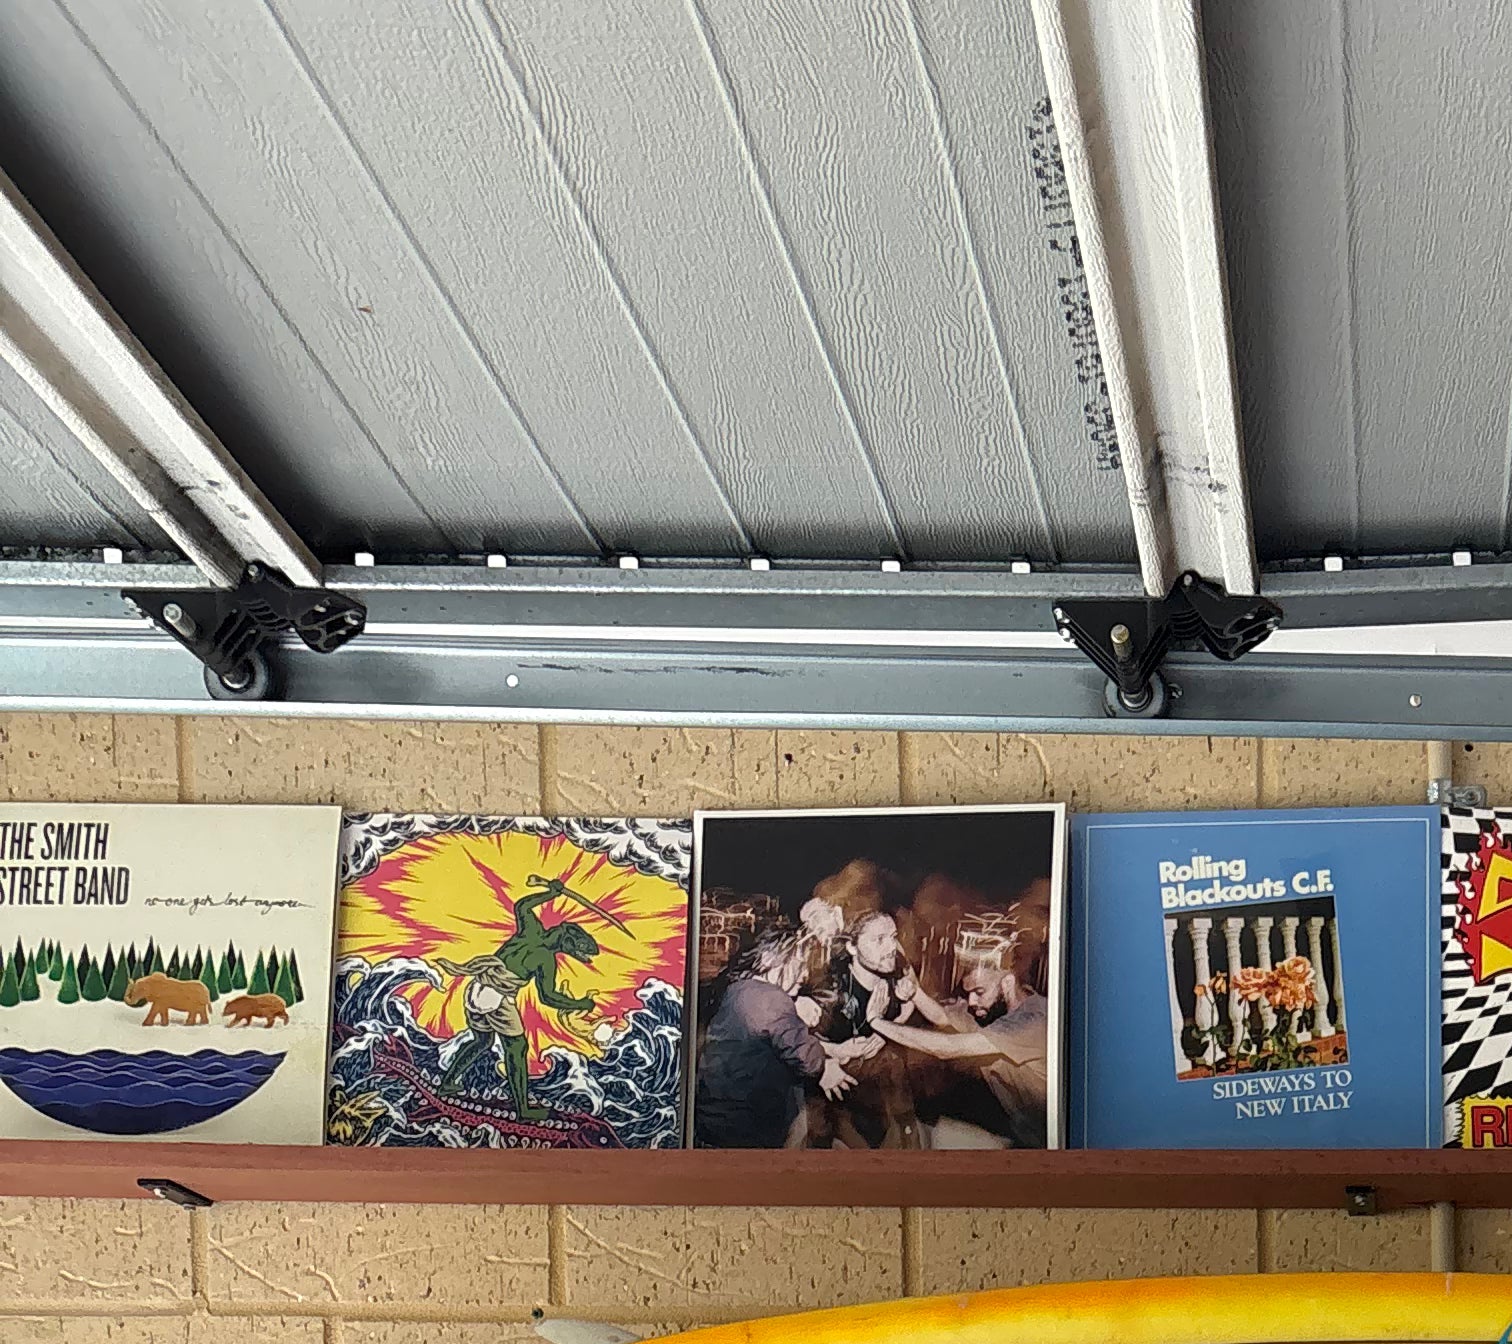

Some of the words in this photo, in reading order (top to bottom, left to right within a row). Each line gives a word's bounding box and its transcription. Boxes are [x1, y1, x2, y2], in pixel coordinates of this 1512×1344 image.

[0, 822, 37, 860] THE
[41, 822, 110, 860] SMITH
[74, 866, 130, 905] BAND
[1159, 855, 1247, 884] Rolling
[1161, 877, 1287, 909] Blackouts
[1291, 869, 1335, 895] C.F.
[1213, 1072, 1316, 1100] SIDEWAYS
[1320, 1069, 1353, 1088] TO
[1236, 1097, 1287, 1120] NEW
[1292, 1091, 1354, 1114] ITALY
